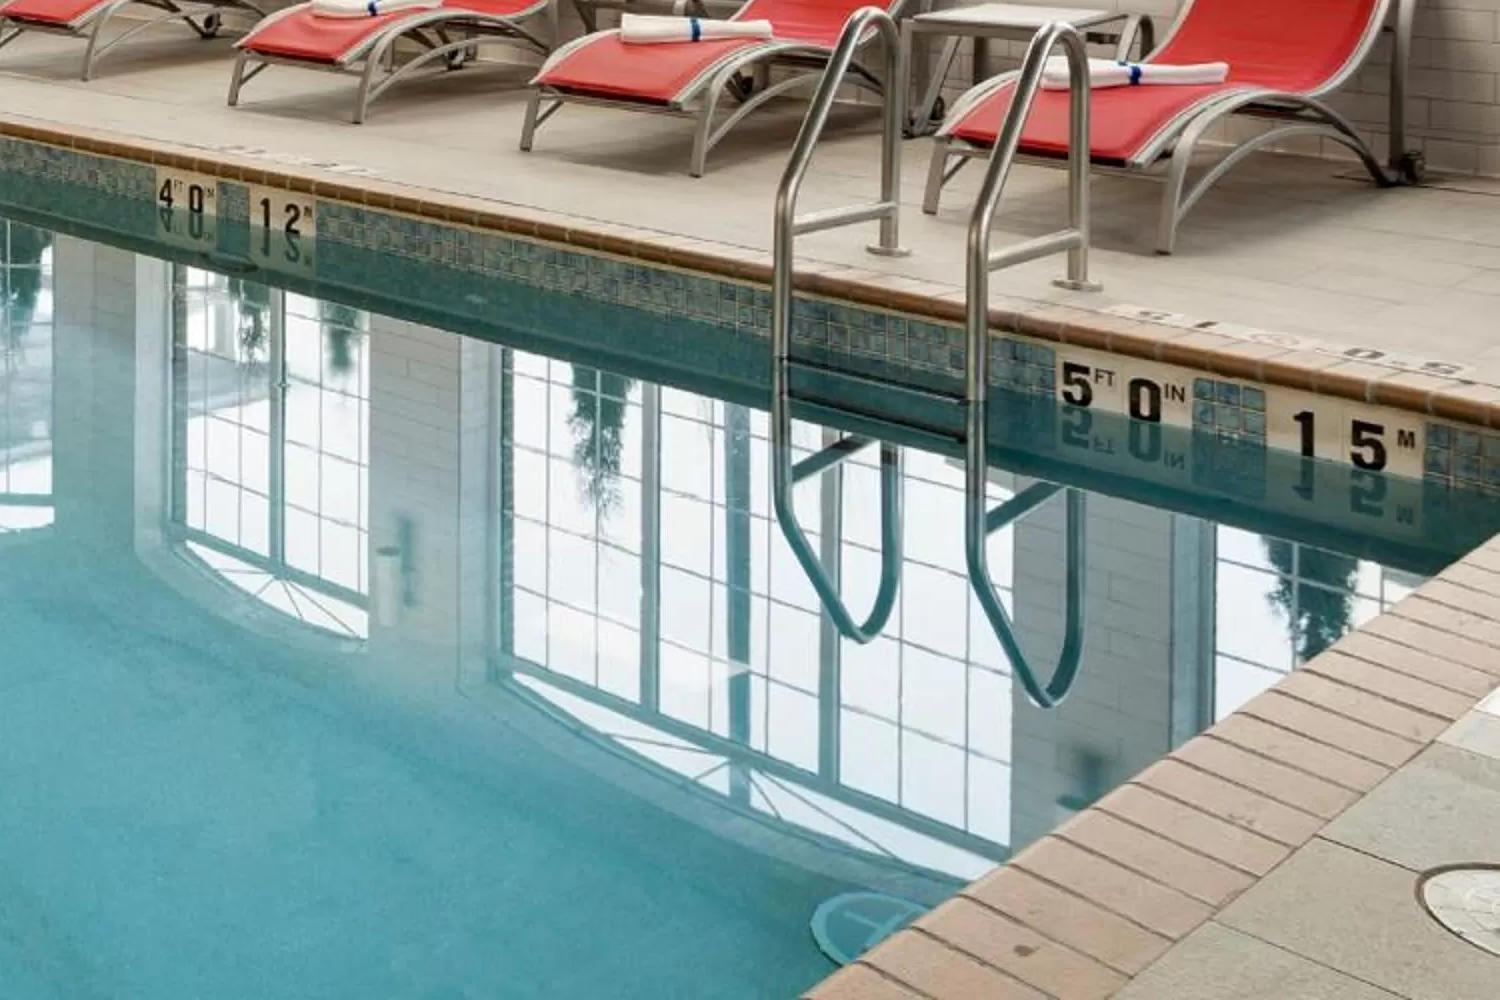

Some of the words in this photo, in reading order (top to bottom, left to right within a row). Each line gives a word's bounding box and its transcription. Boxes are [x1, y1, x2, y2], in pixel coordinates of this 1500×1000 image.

[159, 178, 174, 208] 4
[189, 183, 203, 213] 0
[1062, 361, 1093, 407] 5
[1094, 367, 1116, 387] FT
[1129, 378, 1161, 423] 0
[1164, 384, 1186, 404] IN
[1397, 429, 1415, 449] M
